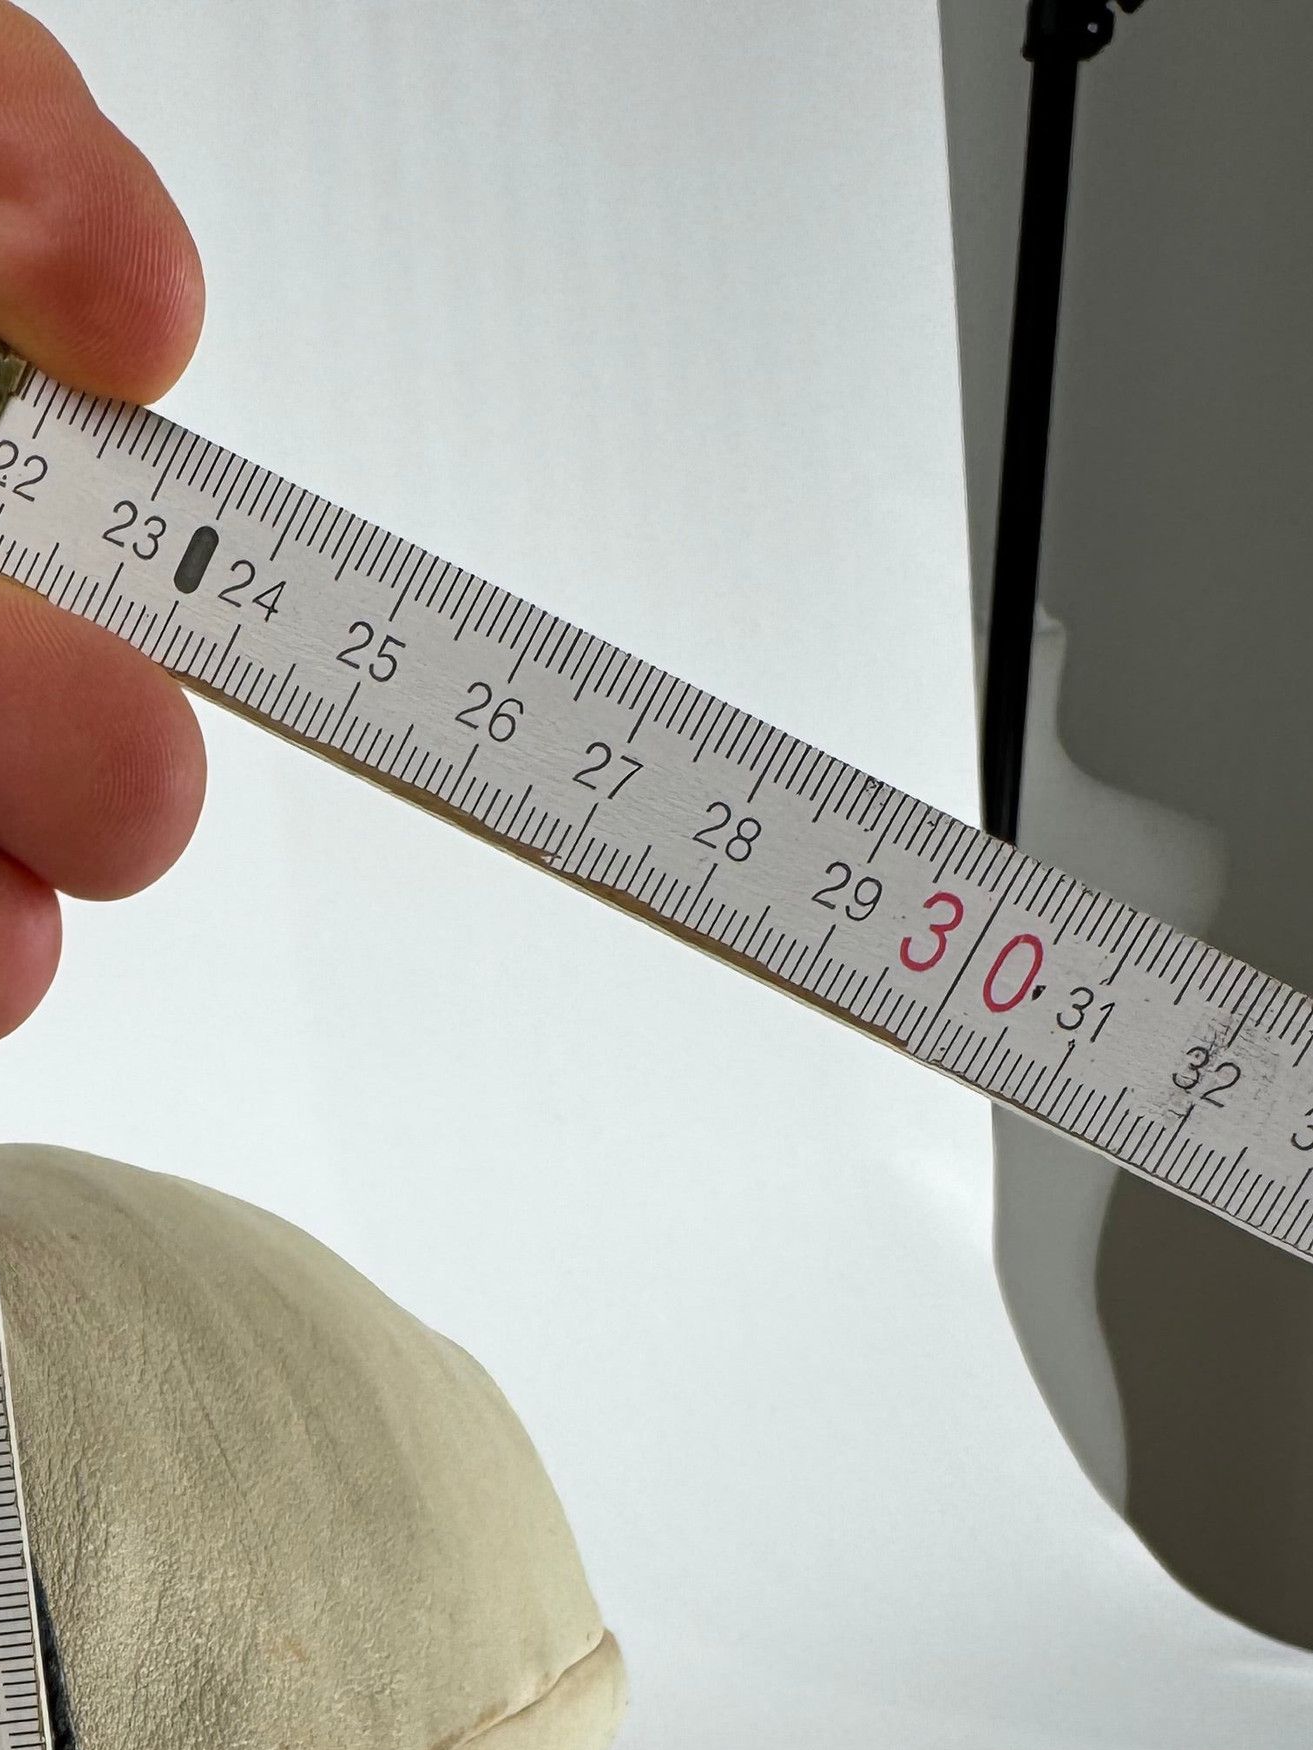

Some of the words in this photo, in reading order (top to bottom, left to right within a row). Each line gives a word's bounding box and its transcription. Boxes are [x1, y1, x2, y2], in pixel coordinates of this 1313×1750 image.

[102, 499, 168, 560] 23
[218, 559, 286, 621] 24
[335, 621, 407, 682] 25
[455, 682, 524, 743] 26
[572, 742, 644, 800] 27
[692, 801, 762, 862] 28
[811, 862, 883, 921] 29
[899, 892, 1044, 1013] 30
[1057, 987, 1116, 1044] 31
[1172, 1046, 1241, 1108] 32
